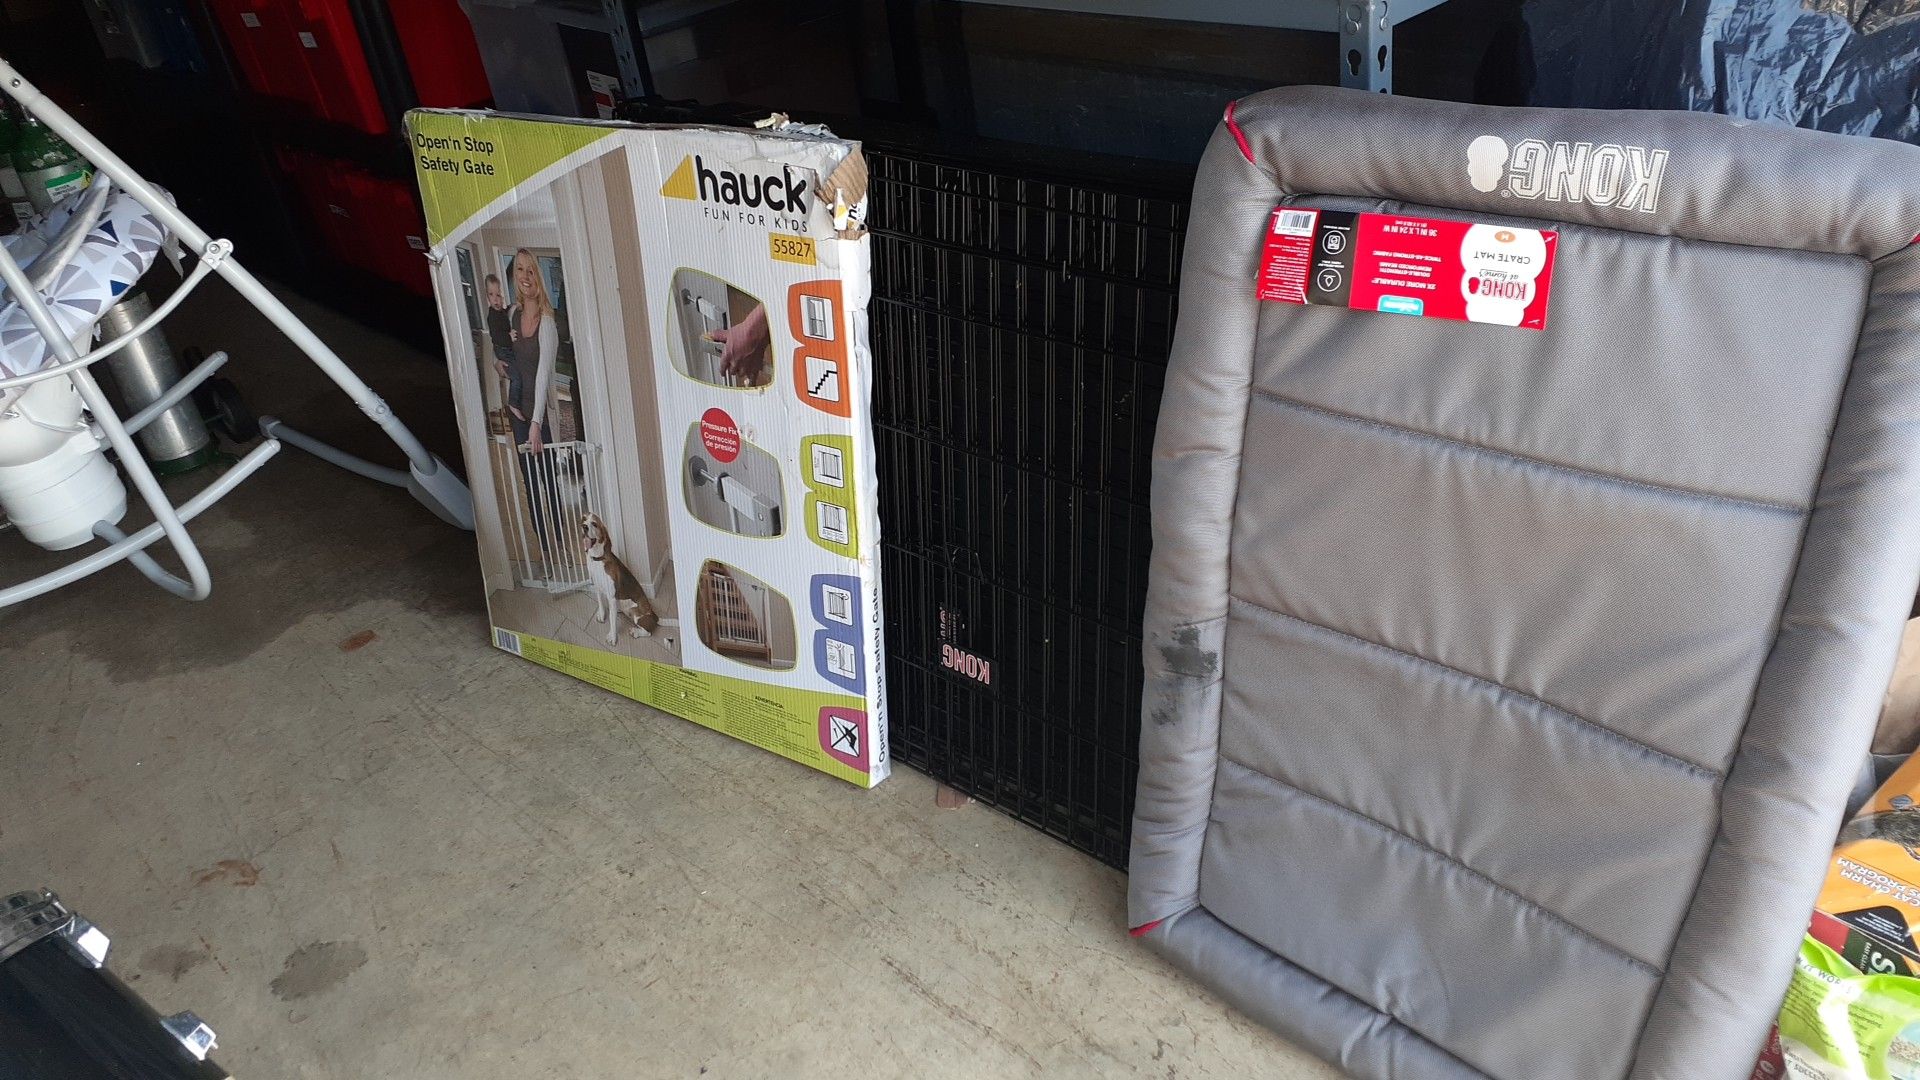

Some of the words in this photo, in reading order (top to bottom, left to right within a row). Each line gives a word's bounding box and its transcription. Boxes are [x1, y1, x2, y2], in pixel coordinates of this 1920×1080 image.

[464, 136, 494, 156] Stop
[420, 156, 459, 175] Safety
[463, 159, 494, 175] Gate
[695, 154, 807, 215] hauck
[704, 207, 730, 221] FUN
[739, 212, 765, 226] FOR
[774, 217, 808, 232] KIDS
[1383, 224, 1391, 232] W
[1391, 225, 1398, 233] IN
[1400, 226, 1408, 234] 24
[1409, 226, 1414, 234] X
[1415, 227, 1420, 235] L
[1420, 228, 1428, 236] IN
[1428, 229, 1438, 237] 36
[774, 239, 811, 258] 55827
[1473, 250, 1496, 260] MAT
[1498, 253, 1531, 265] CRATE
[1405, 281, 1427, 289] MORE
[1481, 278, 1528, 301] KONG
[702, 420, 728, 433] Pressure
[728, 426, 738, 436] Fix
[704, 431, 737, 446] Corrección
[714, 443, 737, 454] presión
[874, 627, 882, 673] Safety
[943, 644, 990, 685] KONG
[1837, 857, 1906, 893] PROGRAM
[1841, 869, 1890, 894] CHARM
